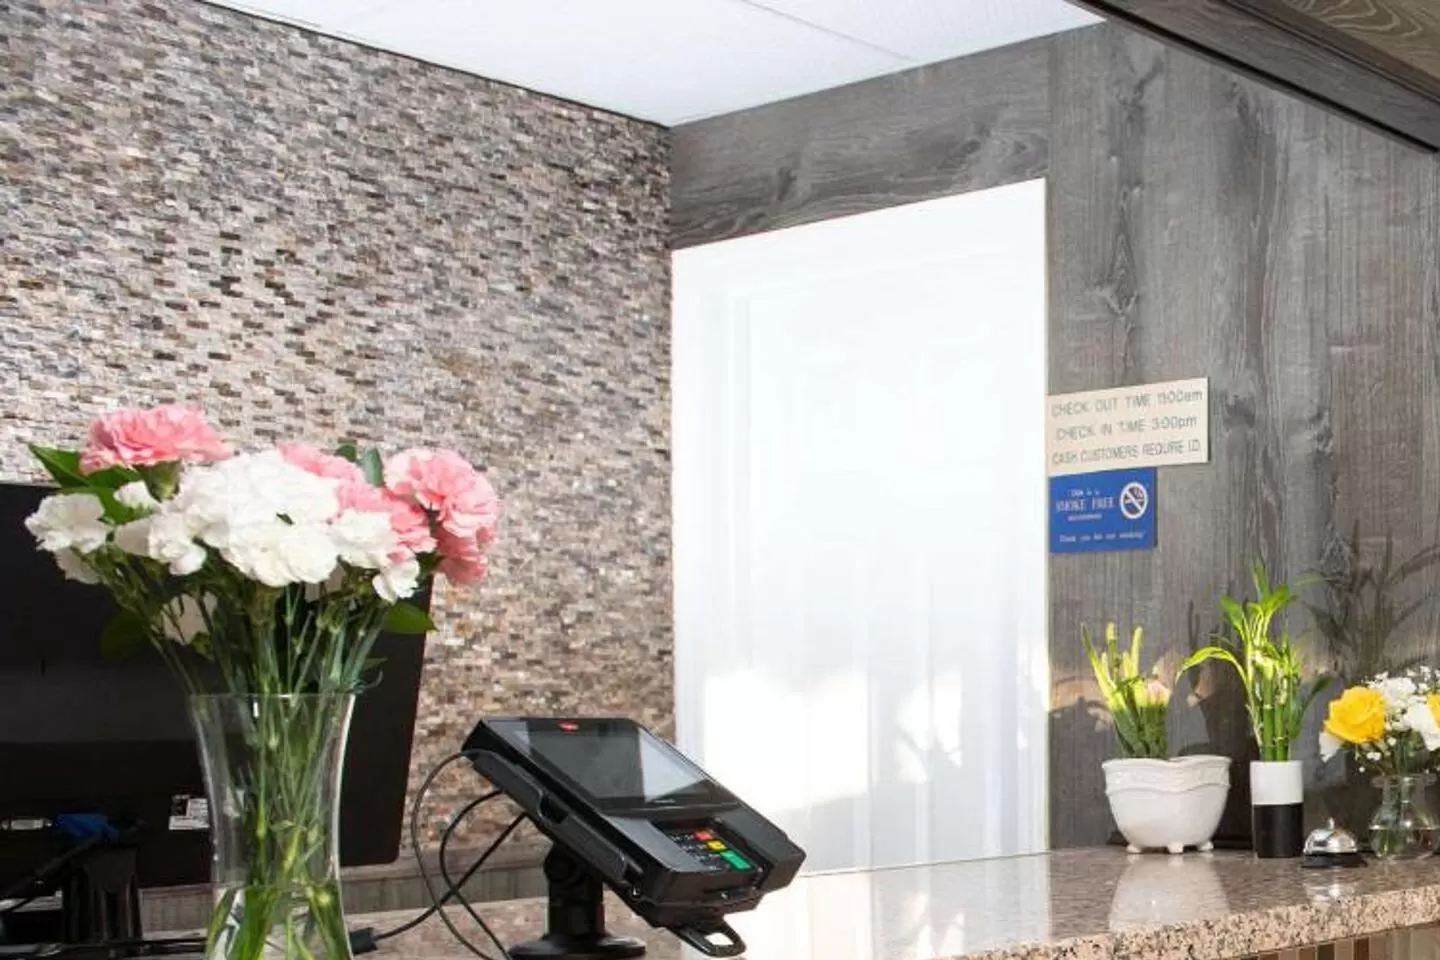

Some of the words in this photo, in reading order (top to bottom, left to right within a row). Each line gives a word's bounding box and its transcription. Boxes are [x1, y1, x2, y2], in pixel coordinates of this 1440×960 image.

[1051, 400, 1089, 418] CHECK
[1095, 397, 1119, 413] OUT
[1125, 392, 1152, 408] TIME
[1056, 424, 1096, 441] CHECK
[1102, 422, 1113, 437] IN
[1116, 418, 1147, 433] TIME
[1151, 415, 1198, 431] 3:00pm
[1052, 451, 1077, 465] CASH
[1080, 444, 1138, 463] CUSTOMERS
[1142, 439, 1184, 456] REQUIRE
